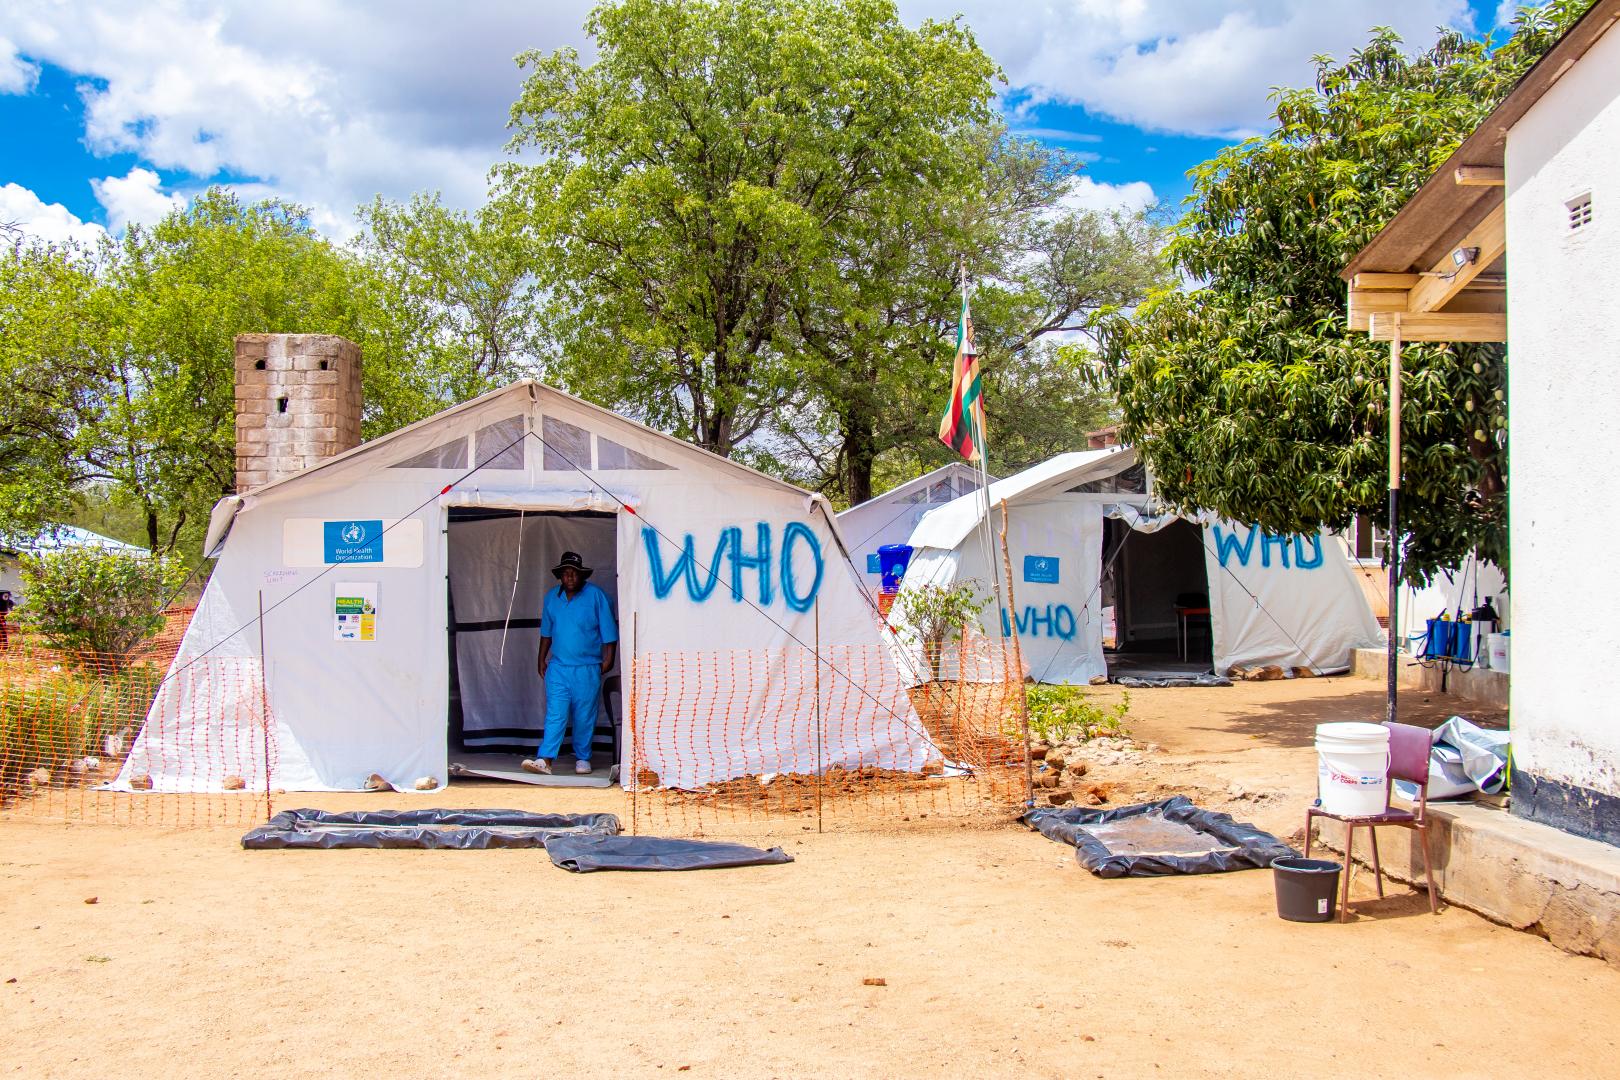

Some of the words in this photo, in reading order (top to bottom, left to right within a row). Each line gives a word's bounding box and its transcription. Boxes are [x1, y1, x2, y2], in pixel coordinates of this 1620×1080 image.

[354, 546, 373, 554] Health
[641, 521, 825, 613] WHO
[1212, 521, 1324, 570] WHO
[1001, 602, 1077, 641] WHO
